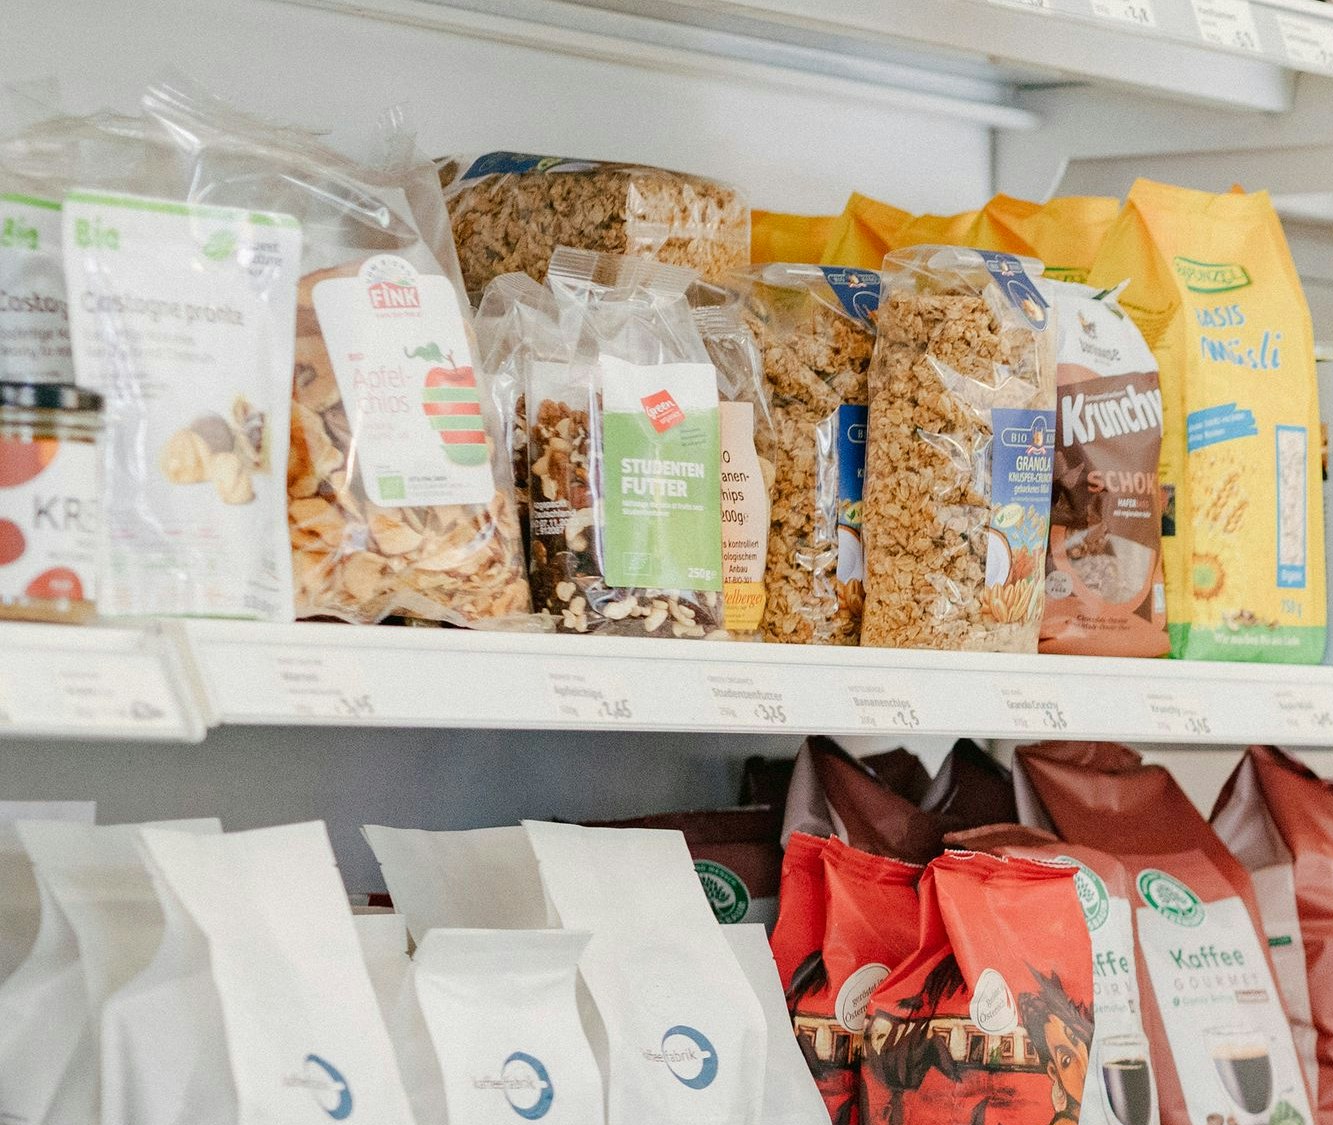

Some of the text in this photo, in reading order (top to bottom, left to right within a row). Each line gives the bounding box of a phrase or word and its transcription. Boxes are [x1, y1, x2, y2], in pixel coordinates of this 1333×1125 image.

[371, 286, 419, 308] FINK
[1062, 384, 1161, 447] Krunchy
[1011, 434, 1028, 443] BIO
[621, 458, 705, 478] STUDENTEN
[1016, 455, 1051, 471] GRANOLA
[622, 476, 688, 498] FUTTER
[728, 538, 759, 548] kontrolliert
[728, 563, 748, 574] Anbau
[853, 696, 912, 710] Bananenchips
[1170, 946, 1245, 970] Kaffee
